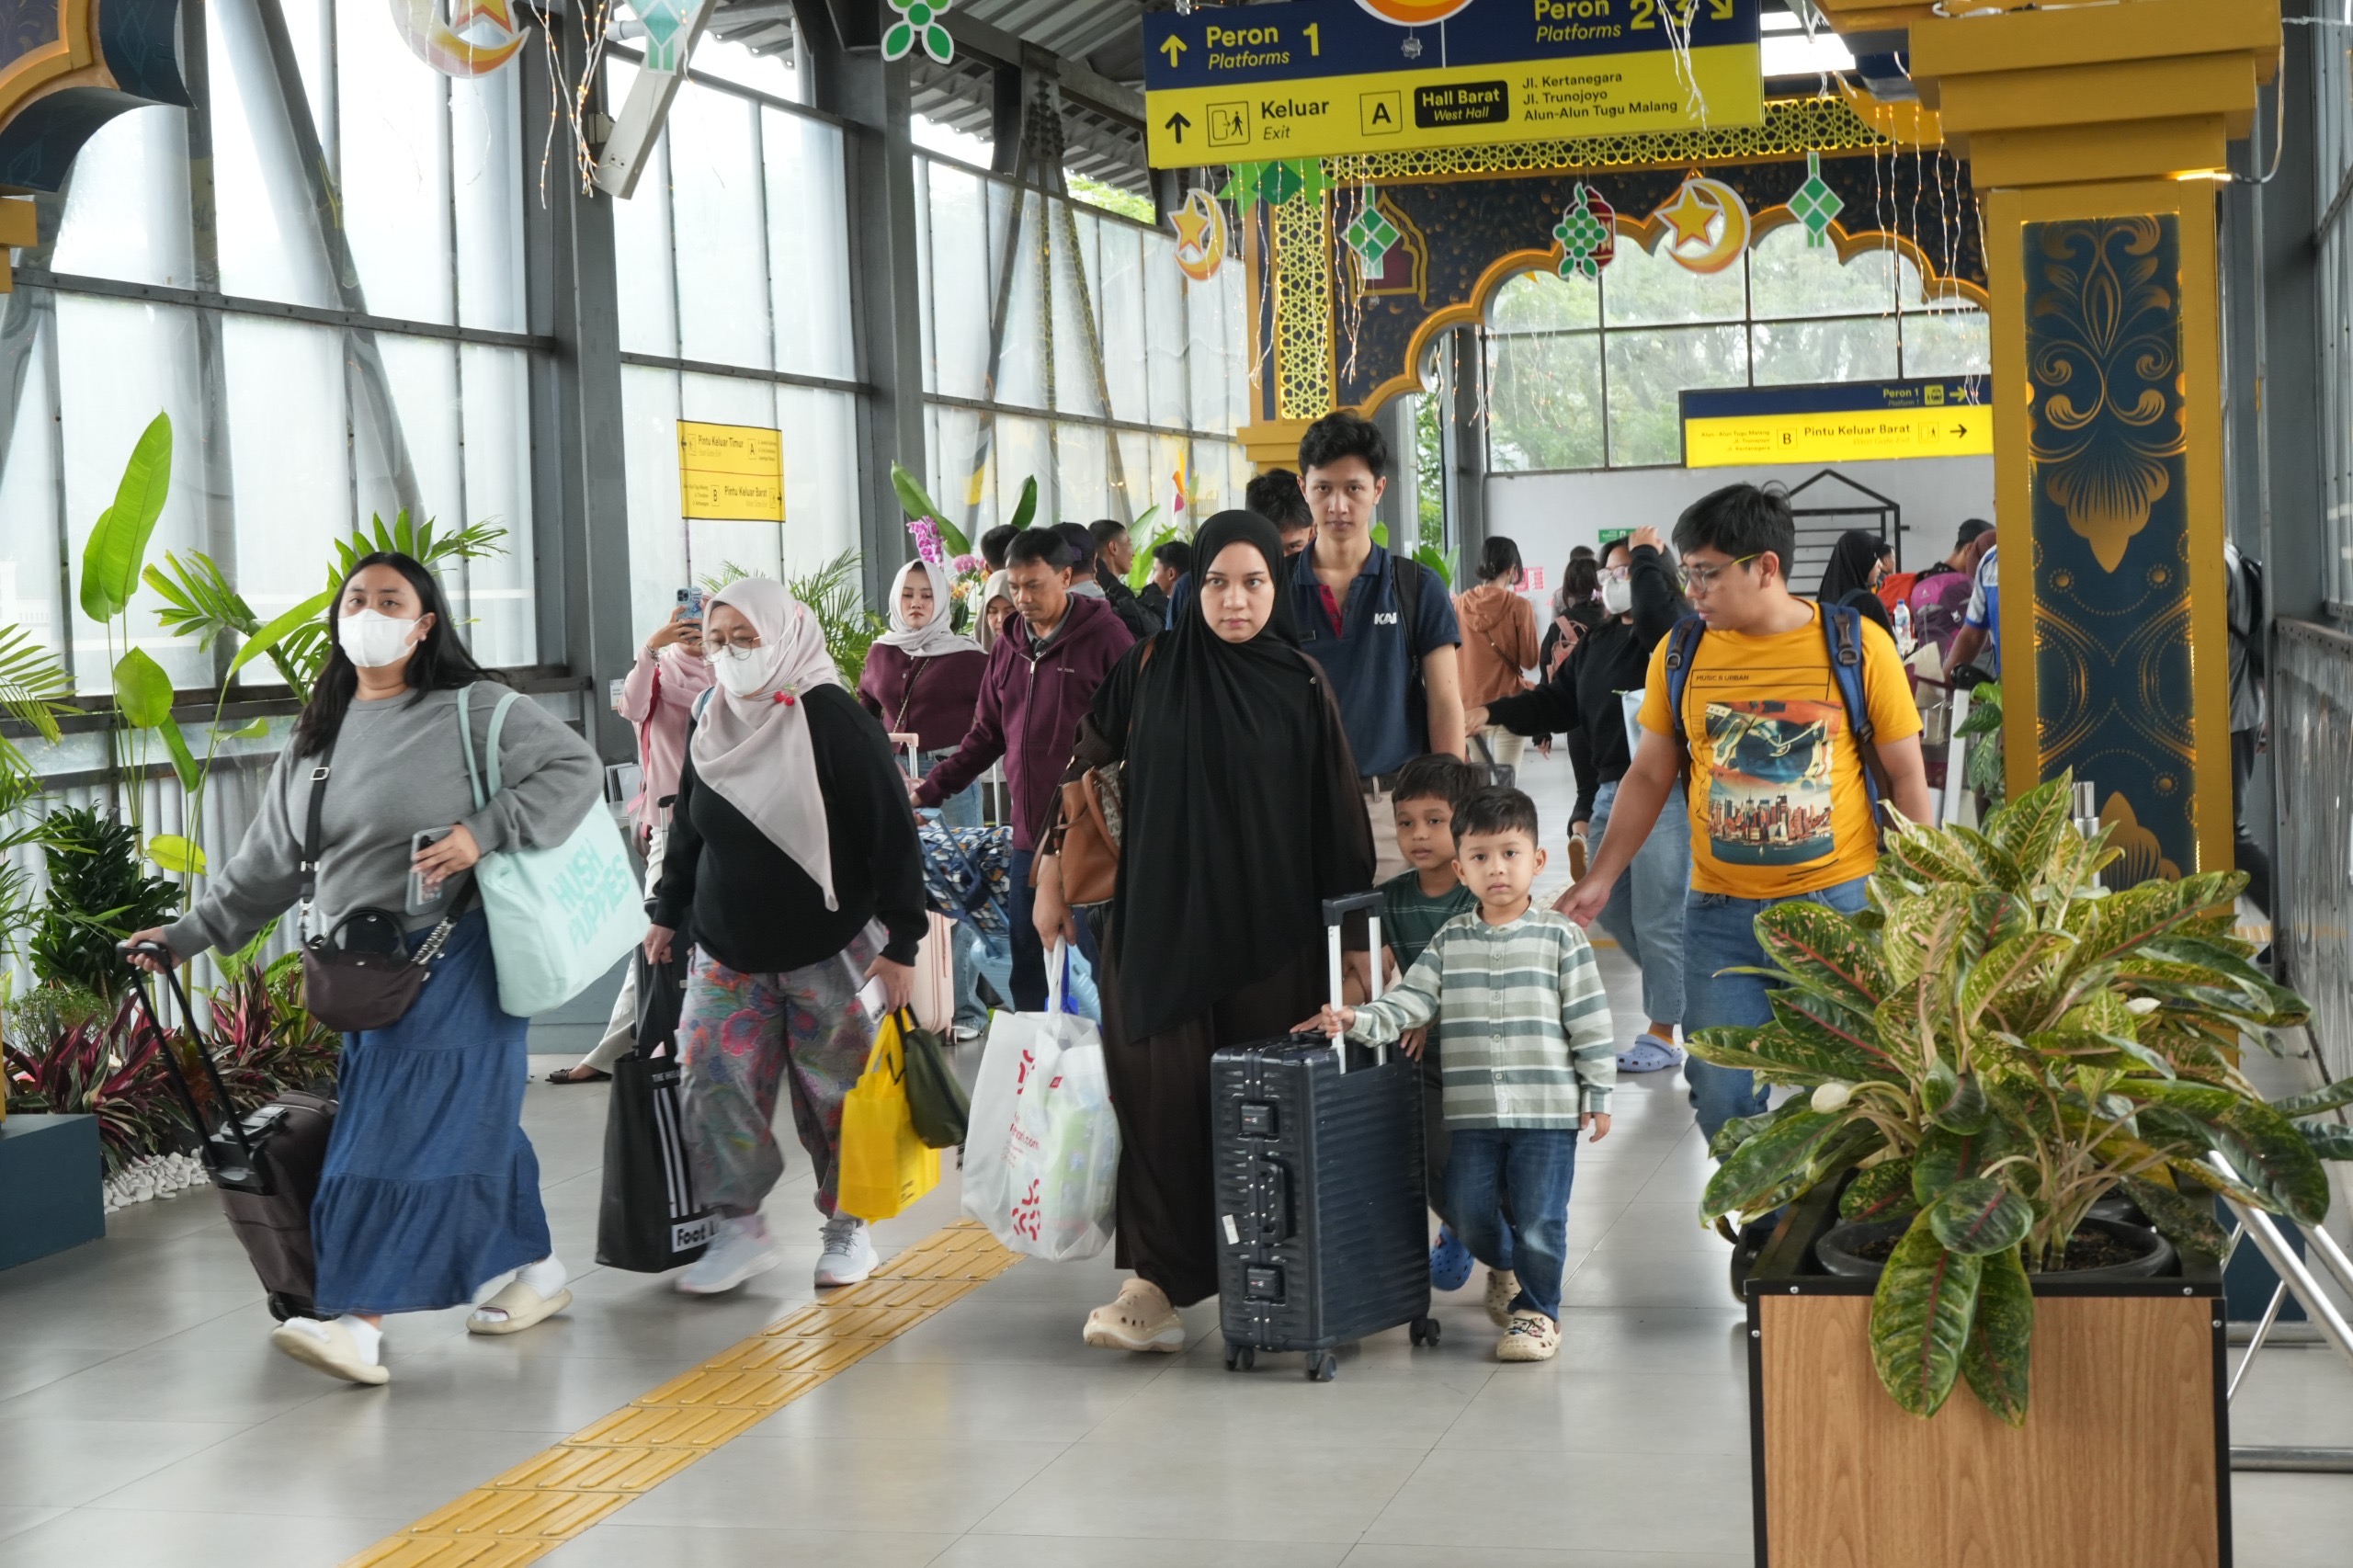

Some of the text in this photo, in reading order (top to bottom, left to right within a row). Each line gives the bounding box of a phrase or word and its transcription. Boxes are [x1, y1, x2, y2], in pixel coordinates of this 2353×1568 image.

[1534, 0, 1609, 21] Peron
[1206, 22, 1319, 56] Peron 1
[1536, 23, 1621, 43] Platforms
[1208, 50, 1290, 70] Platforms
[1542, 72, 1622, 88] Kertanegara
[1422, 87, 1500, 108] Hall Barat
[1544, 89, 1608, 105] Trunojoyo
[1261, 98, 1329, 119] Keluar
[1371, 102, 1392, 125] A
[1434, 106, 1489, 121] West Hall
[1524, 99, 1678, 121] Alun-Alun Tugu Malang
[1263, 125, 1290, 141] Exit
[1883, 388, 1912, 399] Peron
[1782, 432, 1792, 445] B
[1804, 424, 1910, 437] Pintu Keluar Barat
[699, 435, 710, 447] Pintu
[711, 437, 728, 448] Keluar
[729, 437, 744, 448] Timur
[724, 485, 738, 496] Pintu
[739, 486, 755, 497] Keluar
[756, 487, 767, 497] Barat
[1374, 612, 1397, 625] KAI
